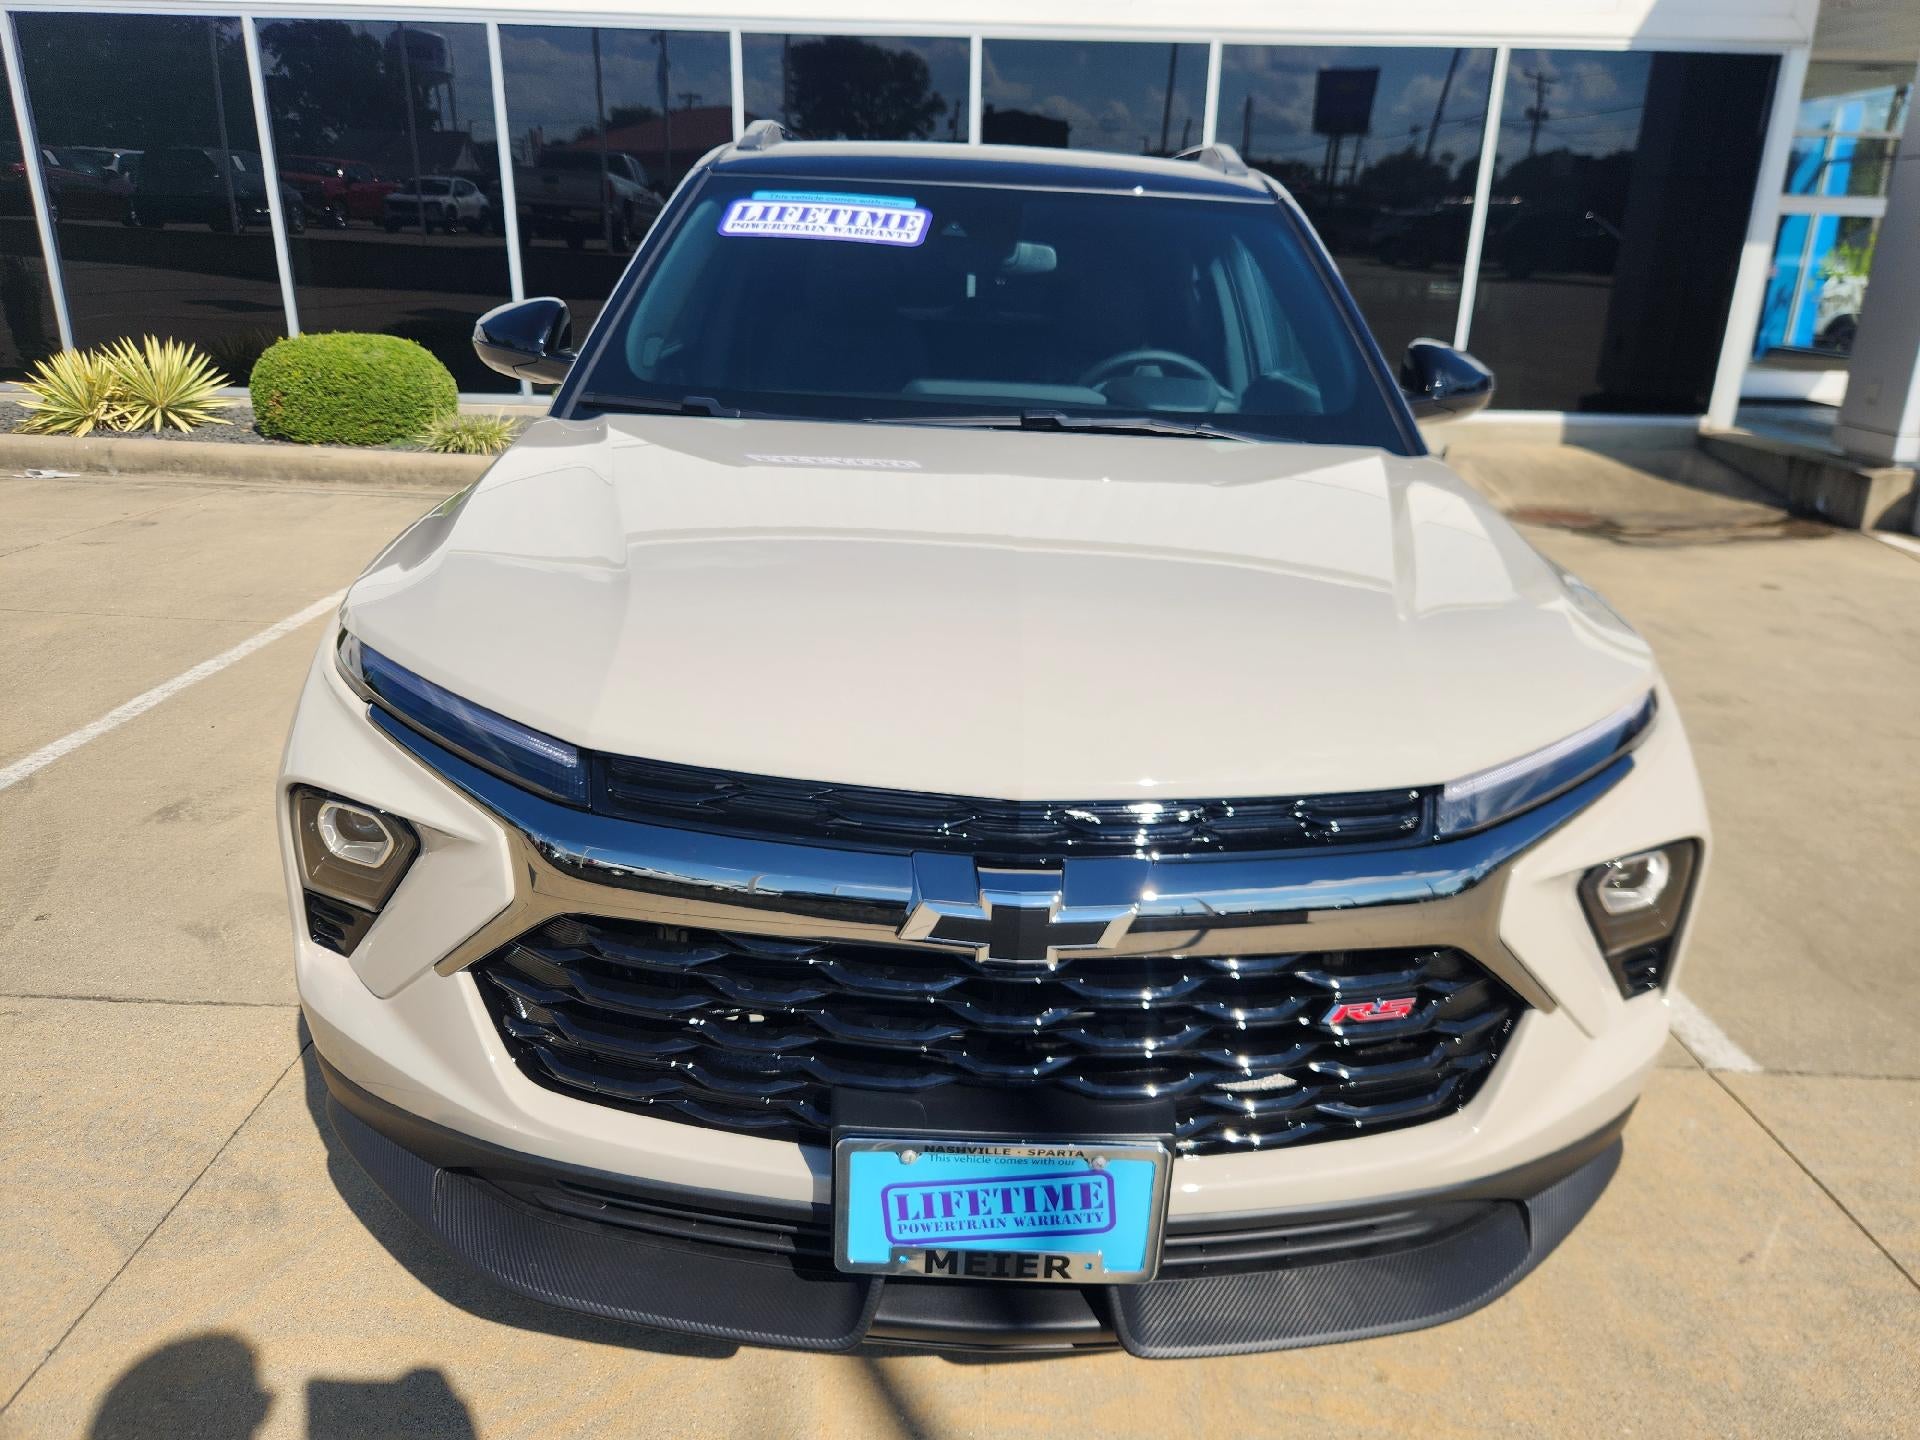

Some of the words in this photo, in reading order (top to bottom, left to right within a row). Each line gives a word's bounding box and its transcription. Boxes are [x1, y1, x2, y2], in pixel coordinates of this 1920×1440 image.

[735, 205, 921, 232] LIFETIME
[731, 222, 826, 234] POWERTRAIN
[833, 226, 915, 240] WARRANTY
[1328, 997, 1416, 1023] RS
[924, 1145, 1011, 1156] NASHVILLE
[1027, 1148, 1085, 1158] SPARTA
[929, 1154, 951, 1163] This
[954, 1154, 991, 1164] vehicle
[994, 1157, 1028, 1165] comes
[1031, 1156, 1056, 1166] with
[893, 1182, 1103, 1221] LIFETIME
[897, 1217, 1006, 1234] POWERTRAIN
[1014, 1212, 1104, 1228] WARRANTY
[924, 1250, 1074, 1280] MEIER
